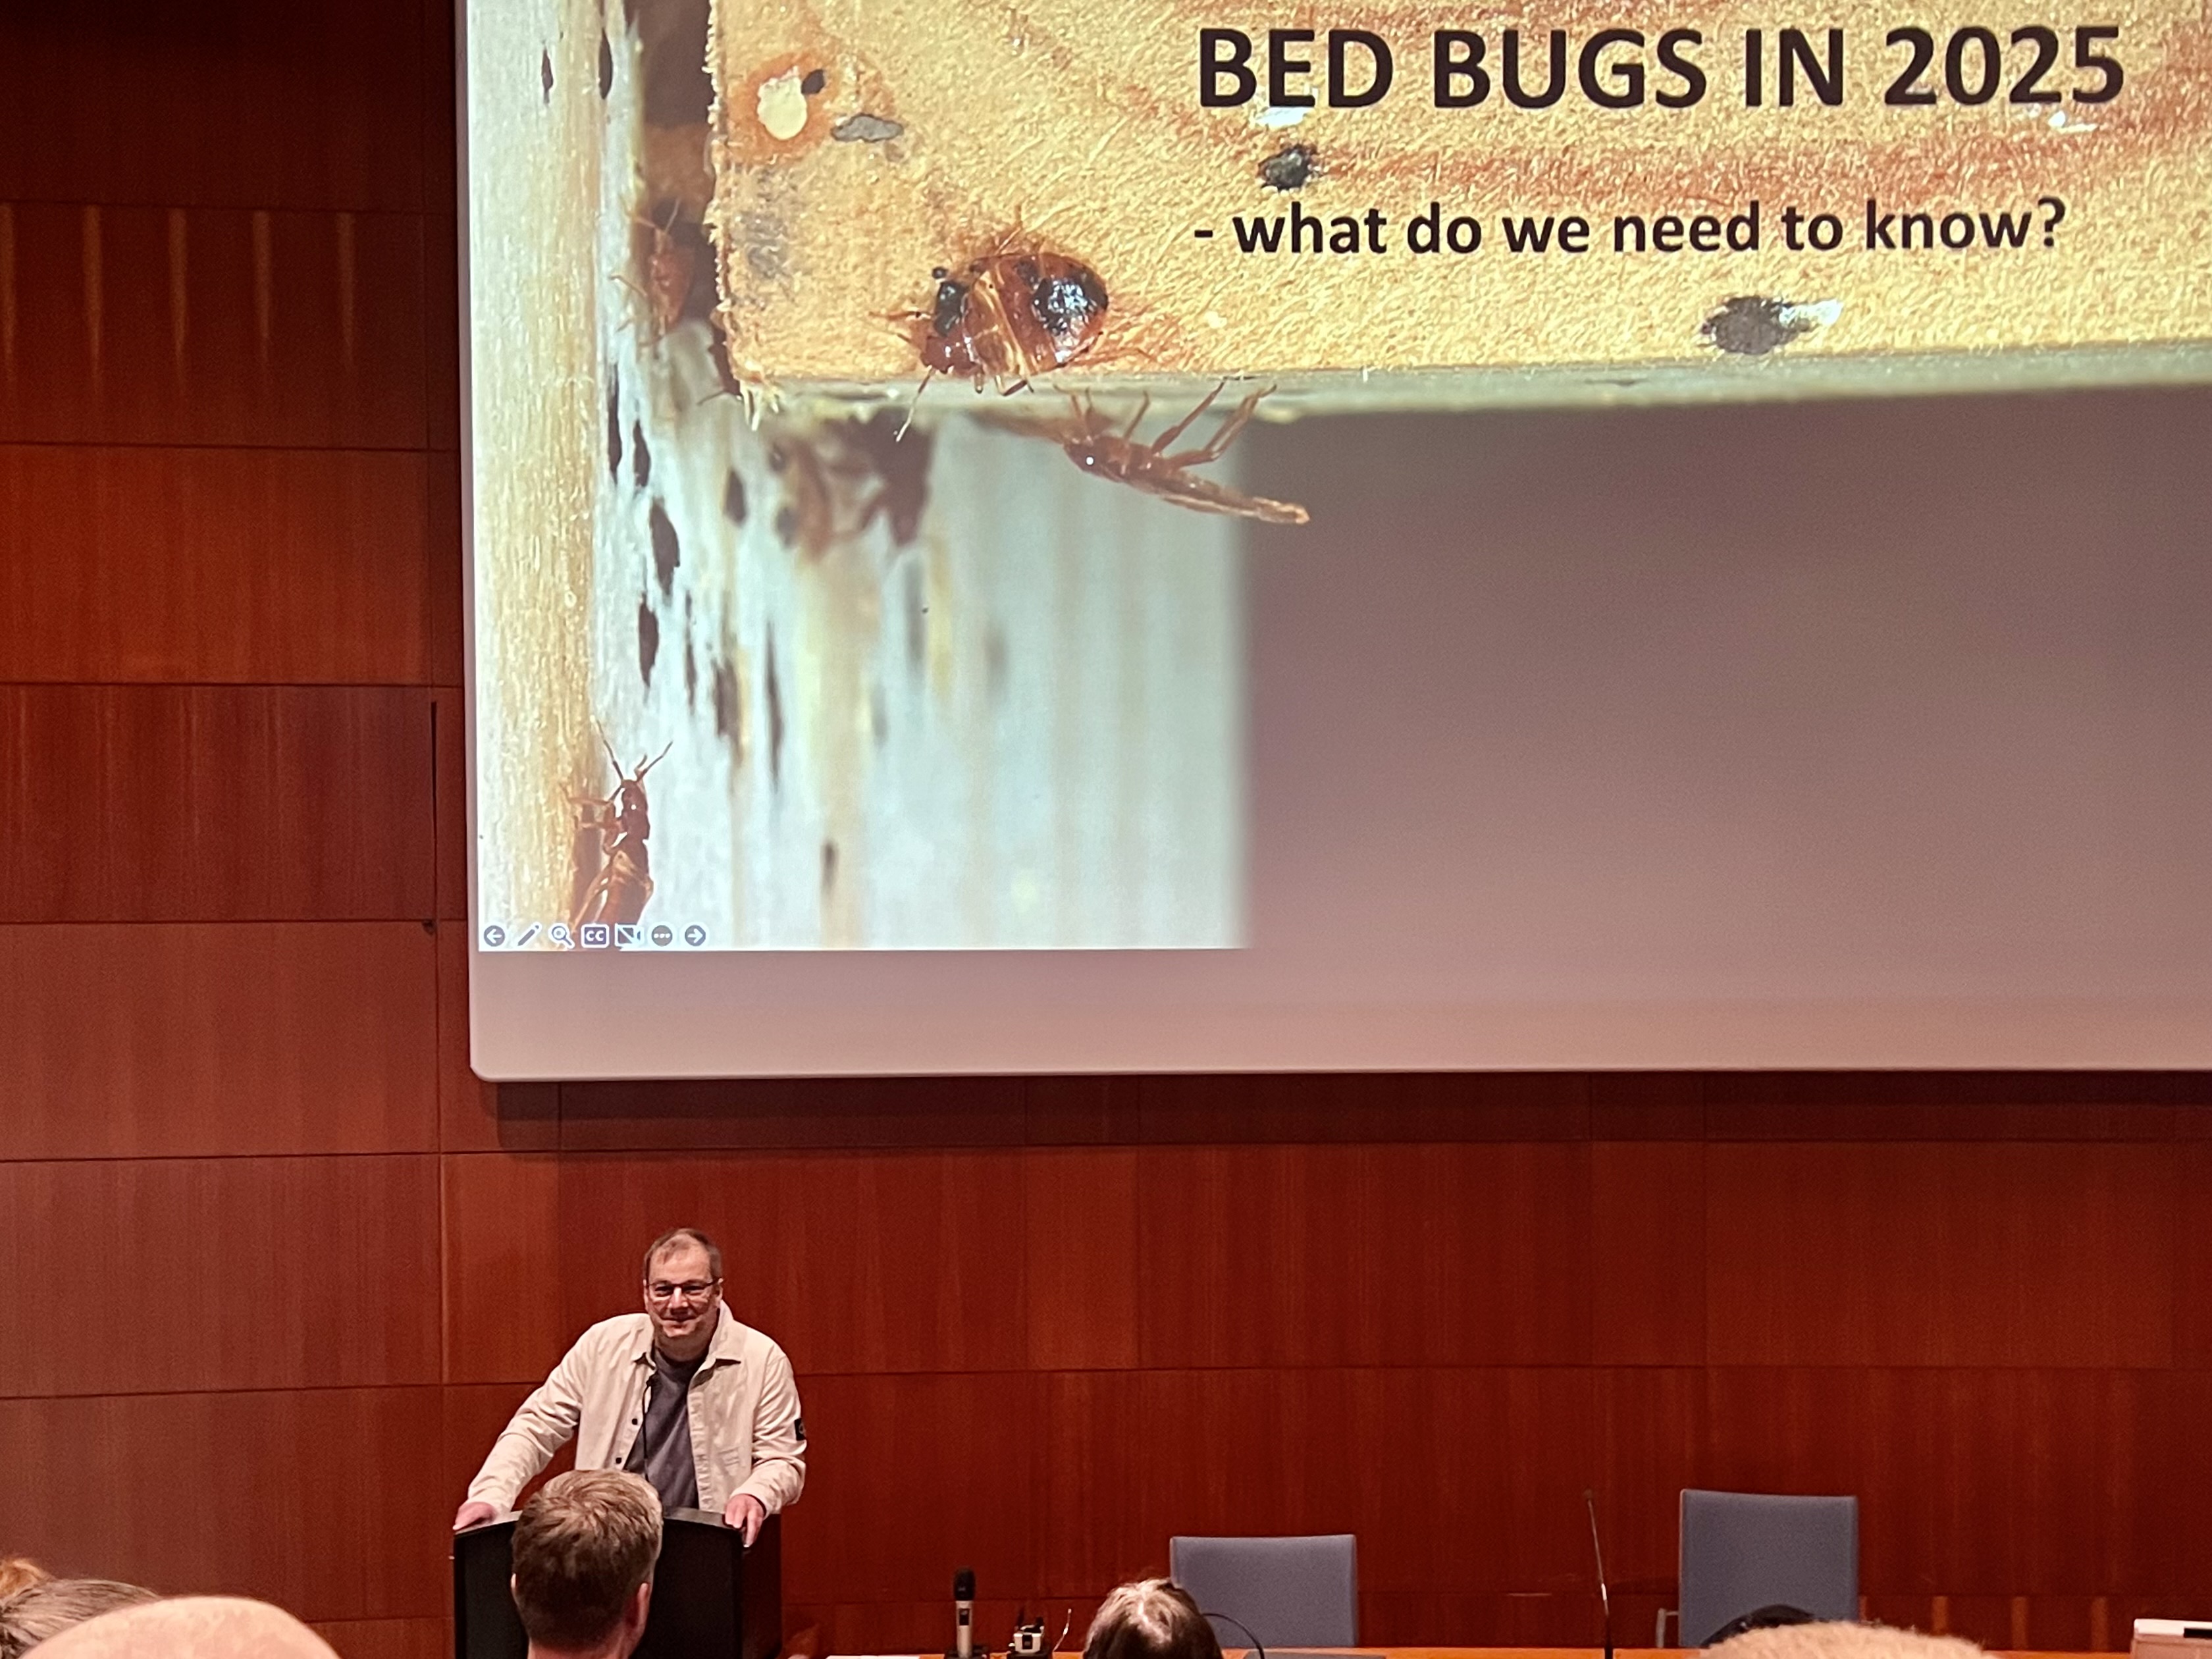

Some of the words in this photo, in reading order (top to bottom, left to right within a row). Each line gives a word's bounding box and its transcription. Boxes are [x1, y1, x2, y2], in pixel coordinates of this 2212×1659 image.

[1199, 28, 1394, 109] BED
[1433, 27, 1707, 109] BUGS
[1745, 27, 1844, 107] IN
[1883, 25, 2124, 107] 2025
[1231, 200, 1388, 255] what
[1407, 201, 1482, 254] do
[1501, 215, 1591, 253] we
[1614, 199, 1760, 253] need
[1780, 206, 1843, 251] to
[1866, 196, 2066, 250] know?
[585, 930, 605, 942] CC
